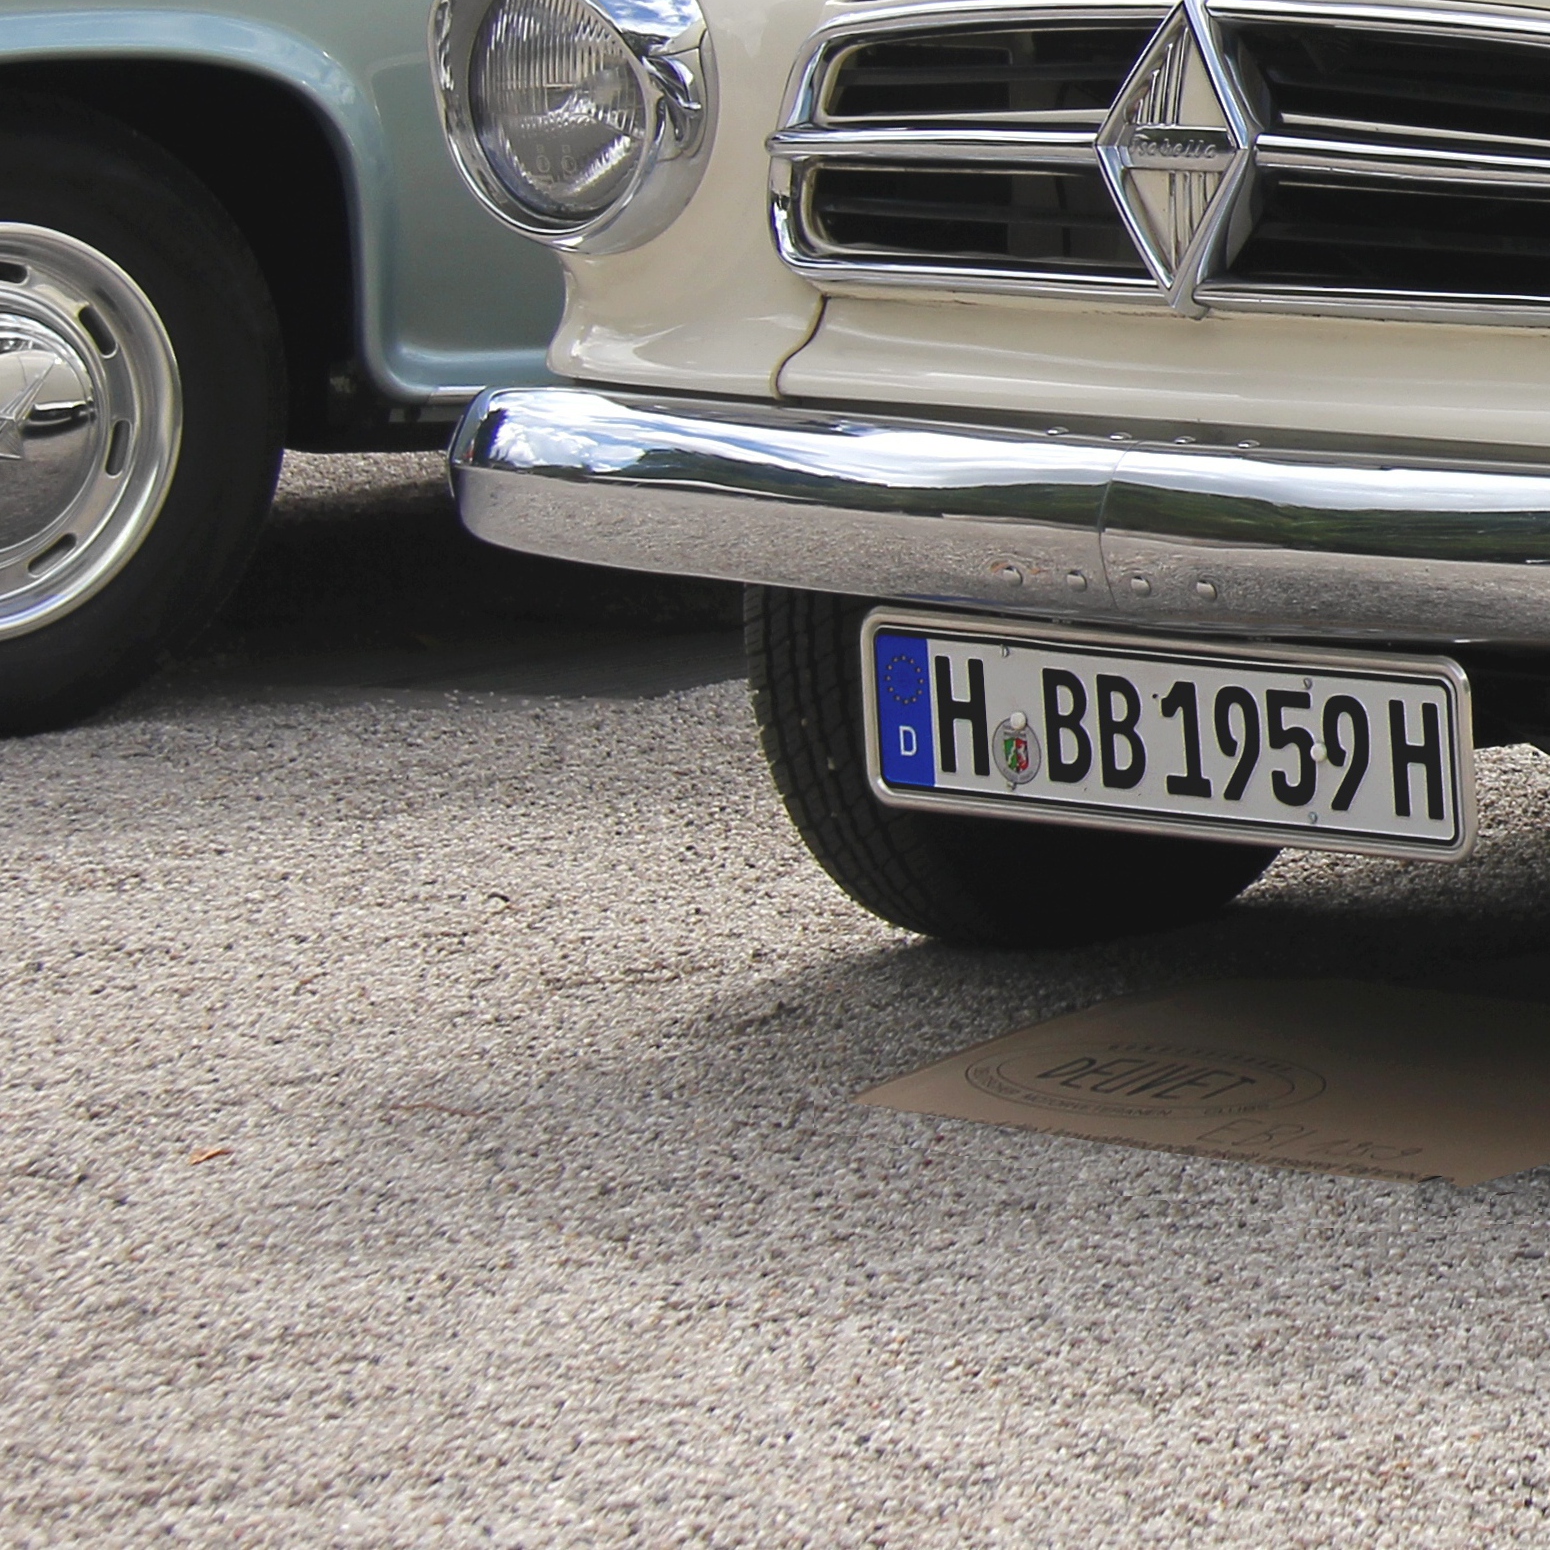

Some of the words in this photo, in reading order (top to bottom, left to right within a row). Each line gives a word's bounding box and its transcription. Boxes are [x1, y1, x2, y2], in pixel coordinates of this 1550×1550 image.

[1129, 134, 1218, 159] Isabella
[934, 655, 991, 777] H
[899, 724, 918, 758] D
[1037, 1056, 1257, 1101] DEUVET
